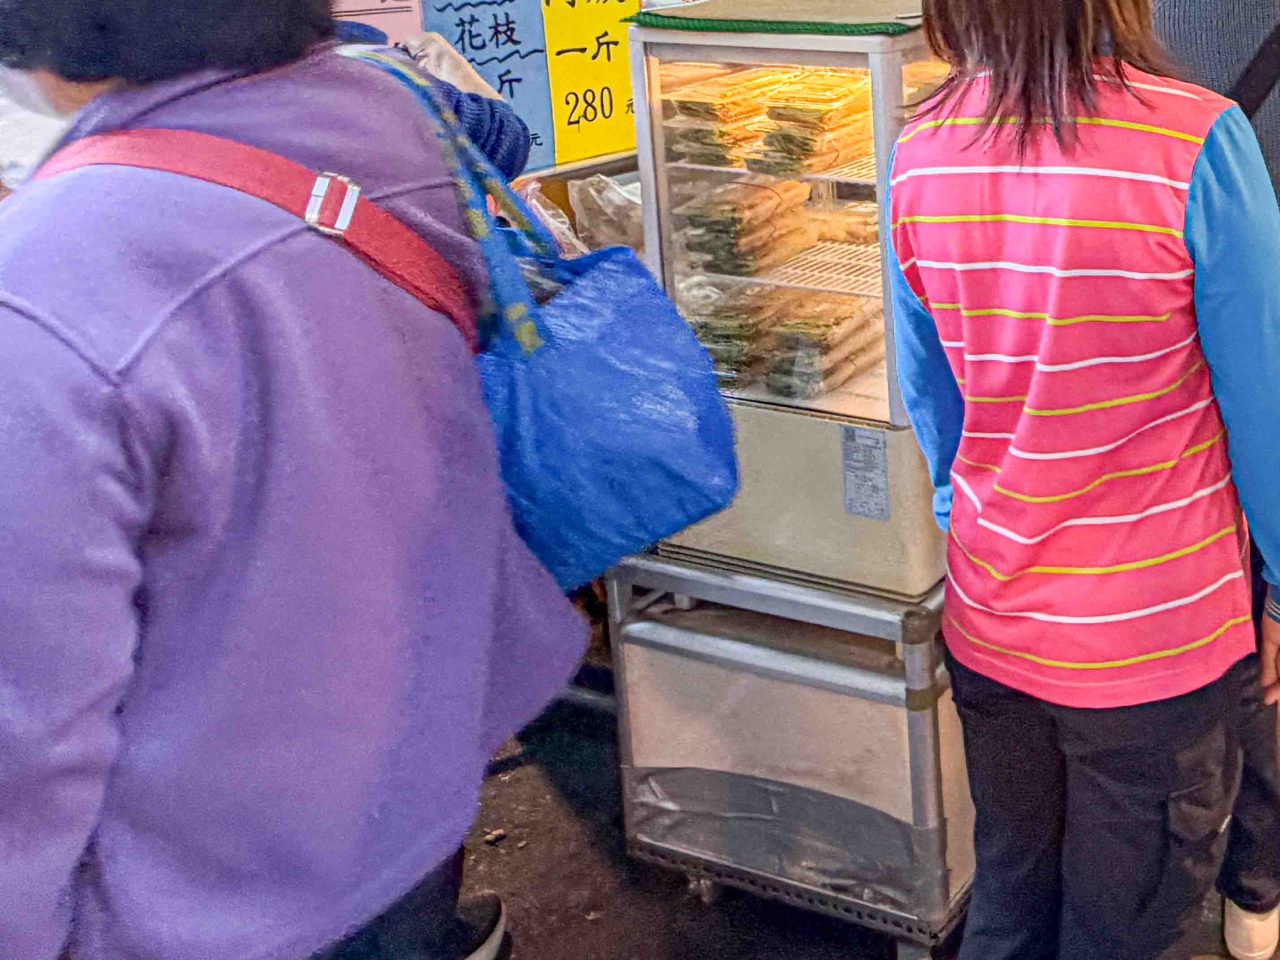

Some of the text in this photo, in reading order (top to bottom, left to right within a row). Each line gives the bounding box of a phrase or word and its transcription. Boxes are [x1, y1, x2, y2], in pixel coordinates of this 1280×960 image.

[453, 11, 522, 54] 花枝
[555, 31, 620, 63] 一斤
[564, 86, 615, 127] 280
